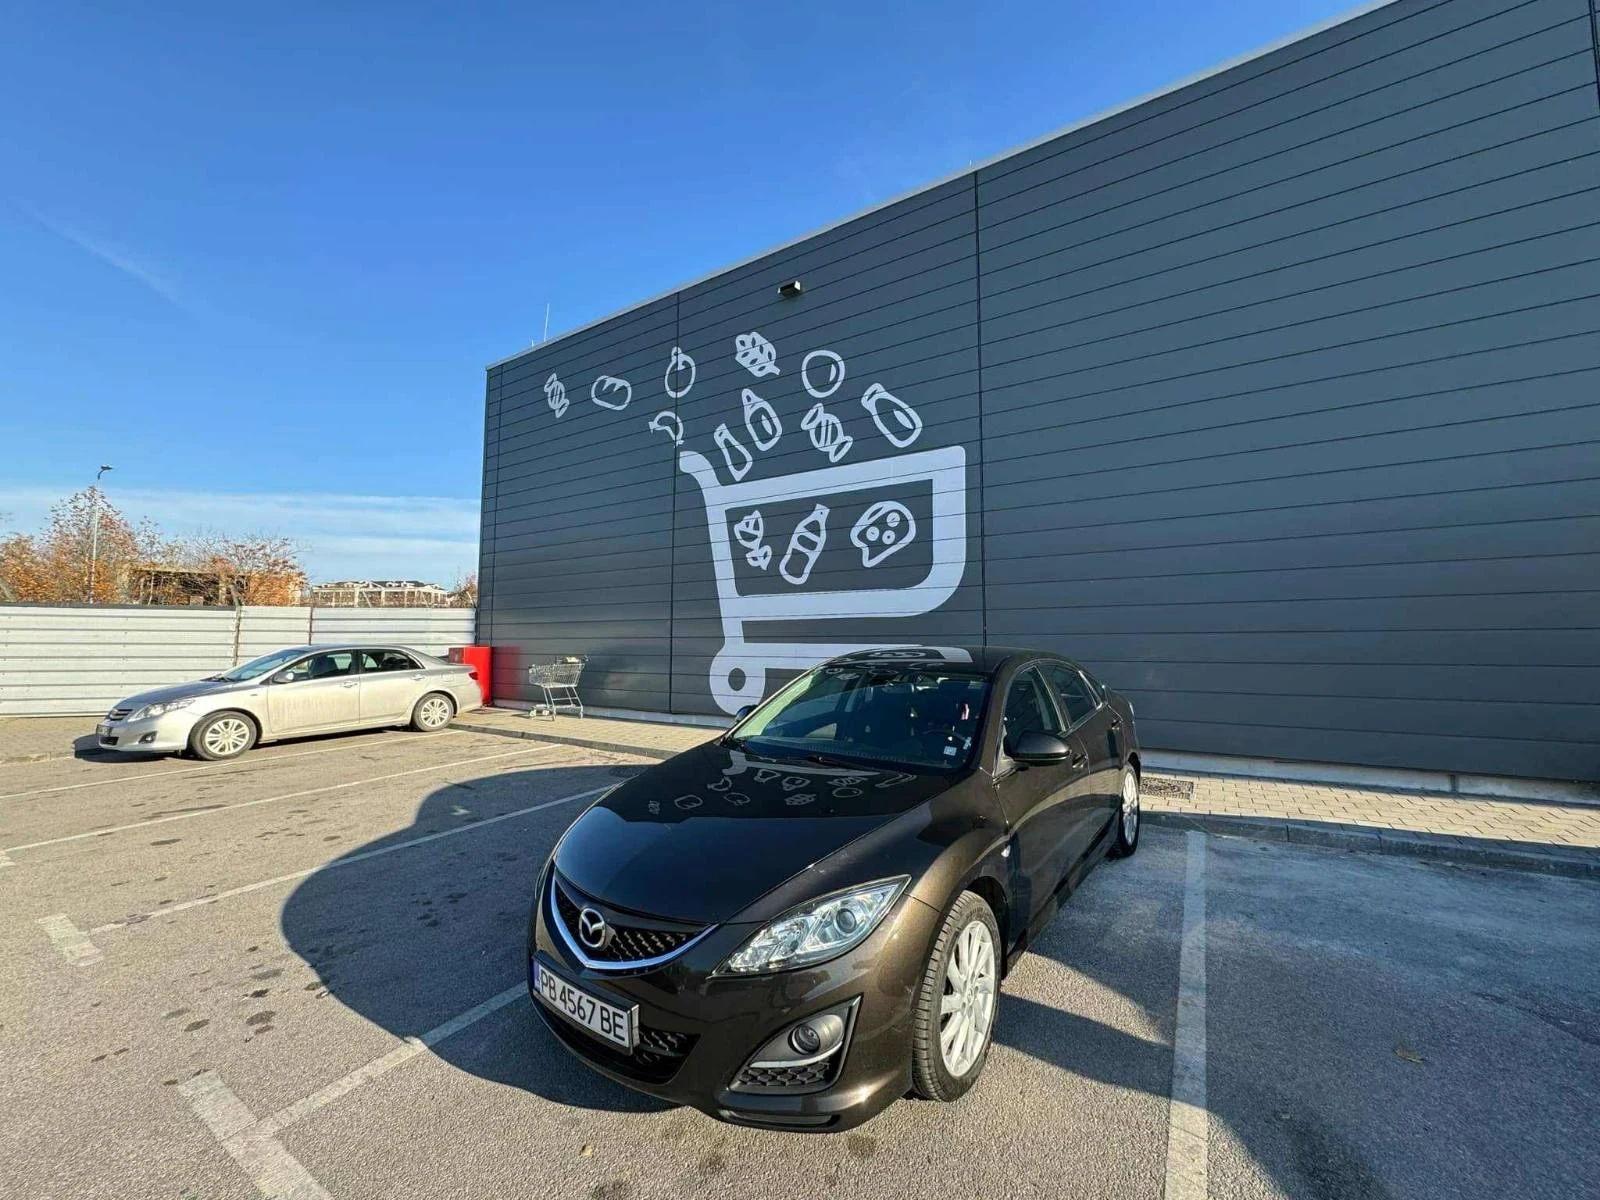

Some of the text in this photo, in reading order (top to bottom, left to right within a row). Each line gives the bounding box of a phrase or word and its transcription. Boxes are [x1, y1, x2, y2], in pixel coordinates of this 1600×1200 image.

[540, 968, 625, 1041] PB 4567 BE
